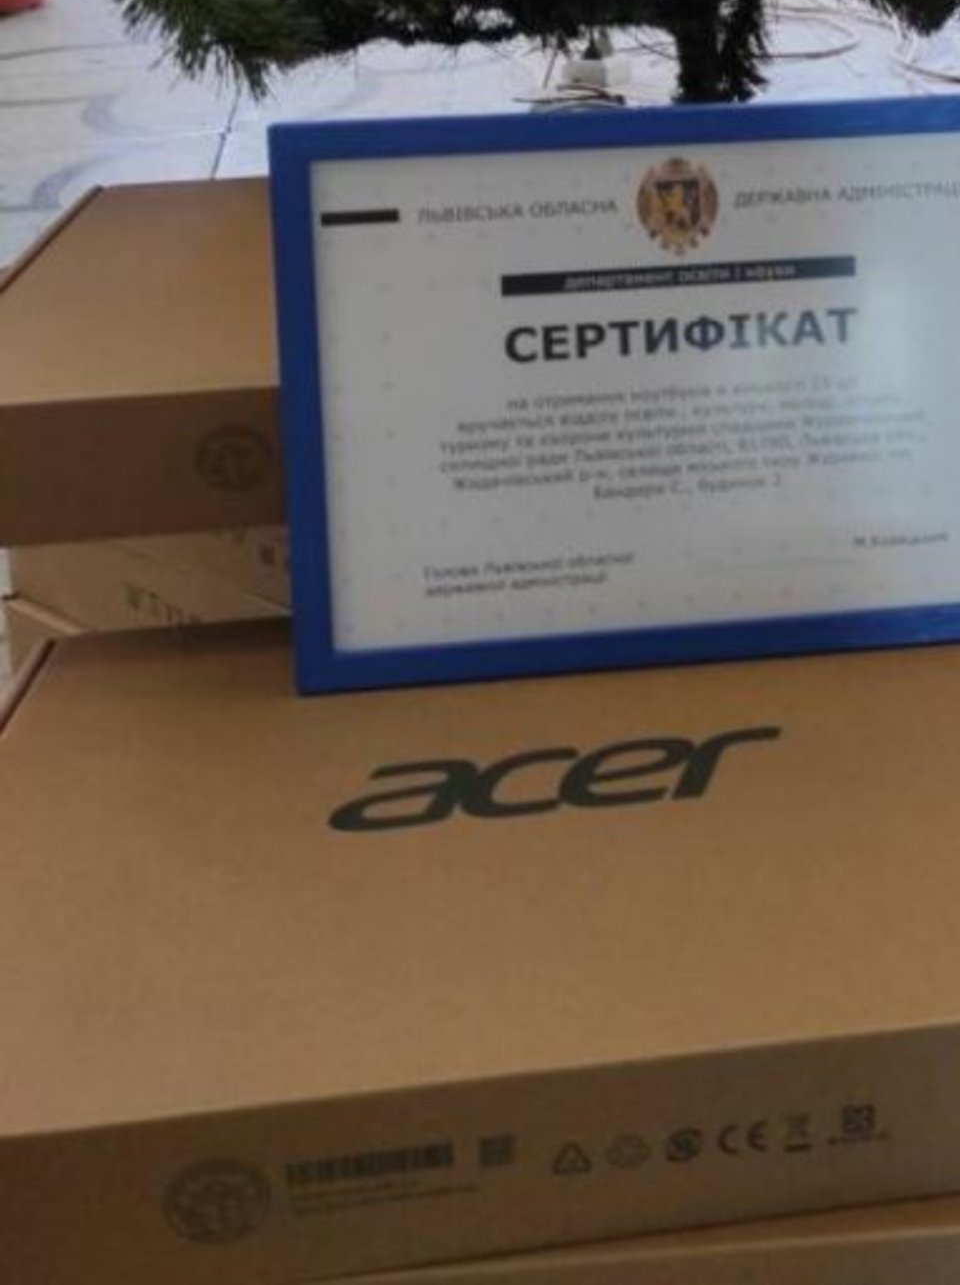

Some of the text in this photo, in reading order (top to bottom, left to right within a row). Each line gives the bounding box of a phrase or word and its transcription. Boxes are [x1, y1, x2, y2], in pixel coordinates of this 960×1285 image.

[529, 198, 619, 218] ОБЛАСНА
[733, 185, 832, 209] ДЕРЖАВНА
[503, 306, 857, 364] СЕРТИФІКАТ
[328, 725, 782, 833] acer
